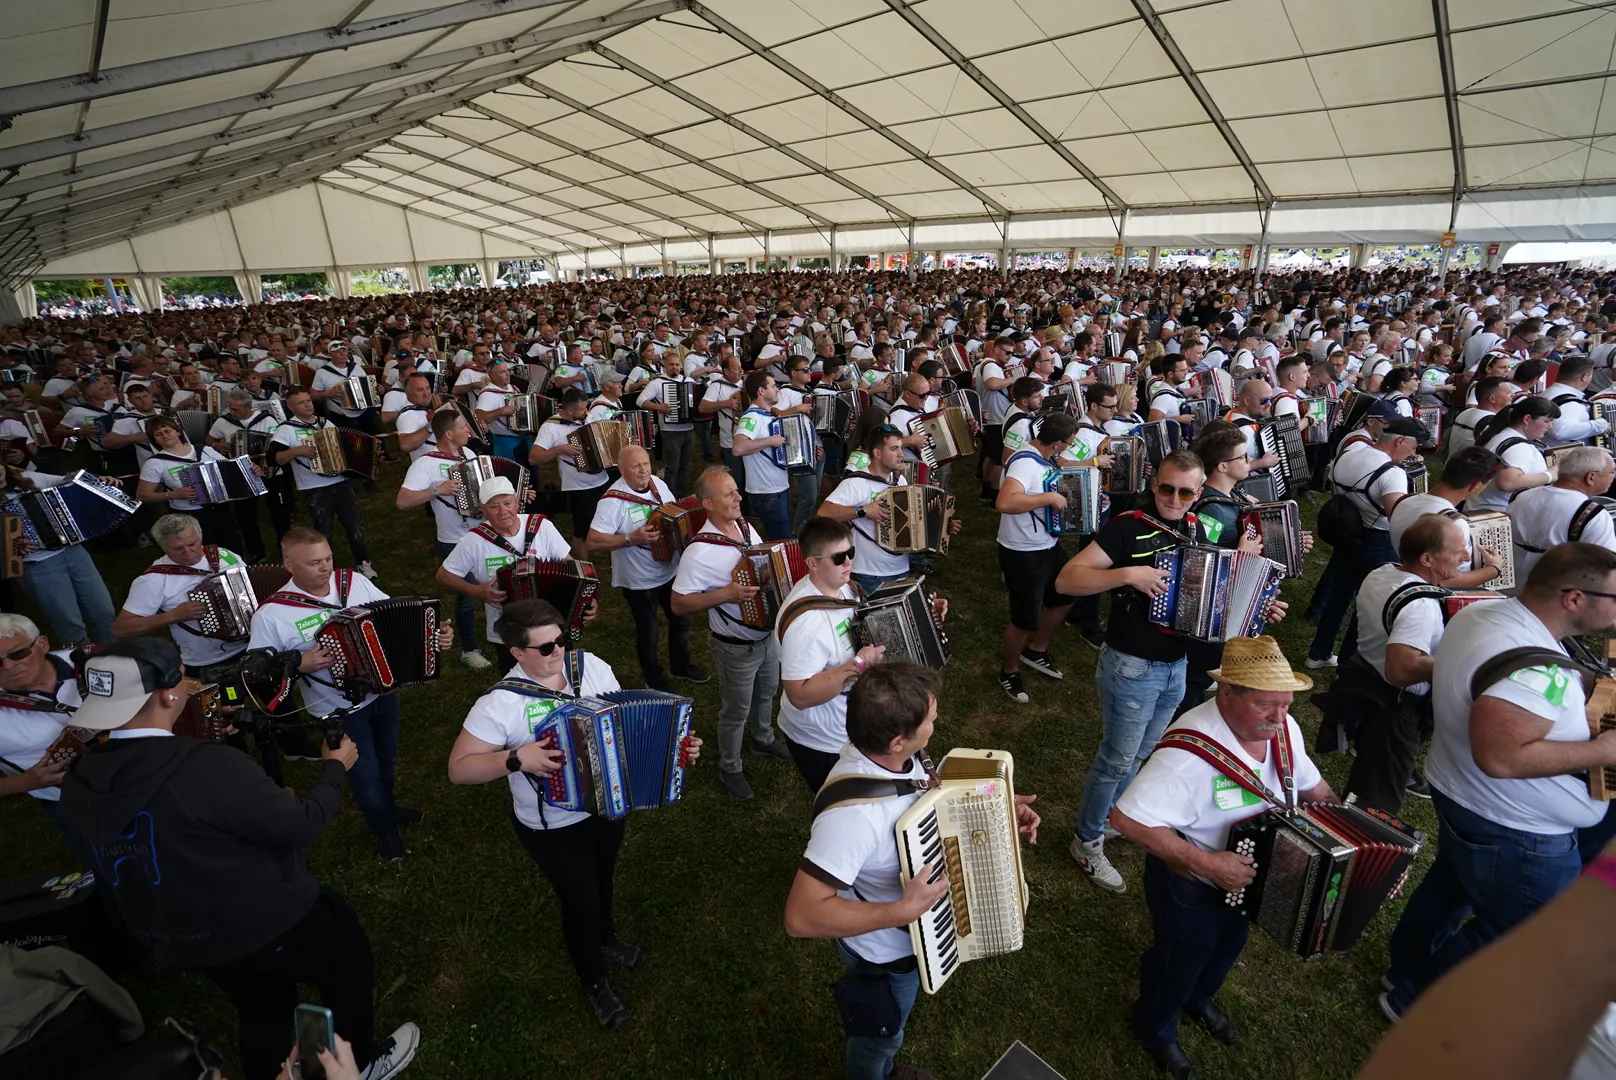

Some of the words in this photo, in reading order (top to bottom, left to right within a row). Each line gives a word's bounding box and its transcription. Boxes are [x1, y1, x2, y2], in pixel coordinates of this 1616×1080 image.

[297, 618, 319, 629] Zelena
[278, 677, 291, 702] RONIN
[528, 705, 551, 715] Zelena
